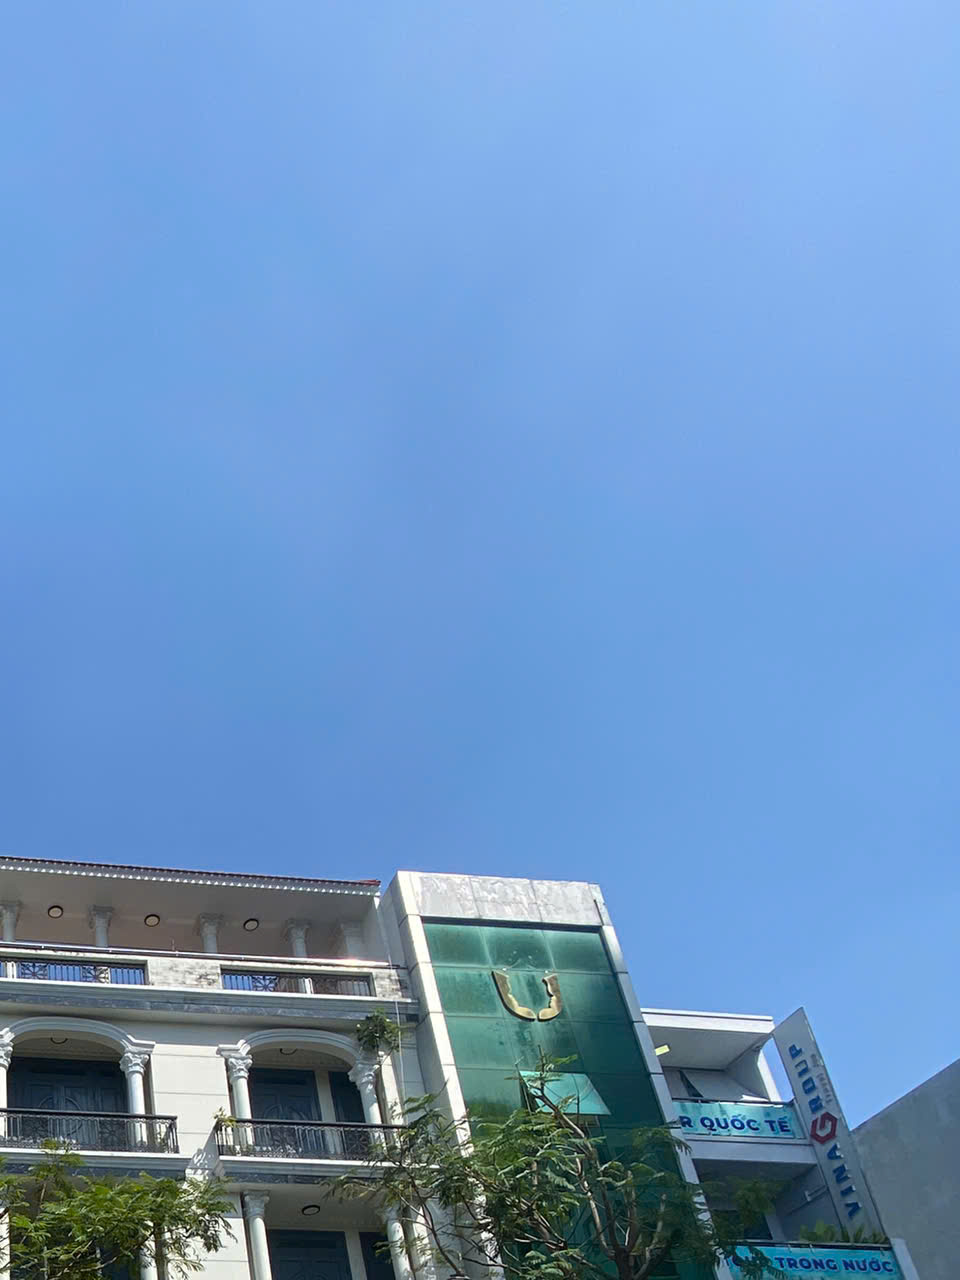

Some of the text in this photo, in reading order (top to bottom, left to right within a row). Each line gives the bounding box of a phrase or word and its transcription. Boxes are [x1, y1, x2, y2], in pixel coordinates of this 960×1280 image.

[700, 1113, 760, 1131] QUỐC
[764, 1115, 791, 1132] TẾ
[774, 1257, 893, 1273] TRONG NƯỚC
